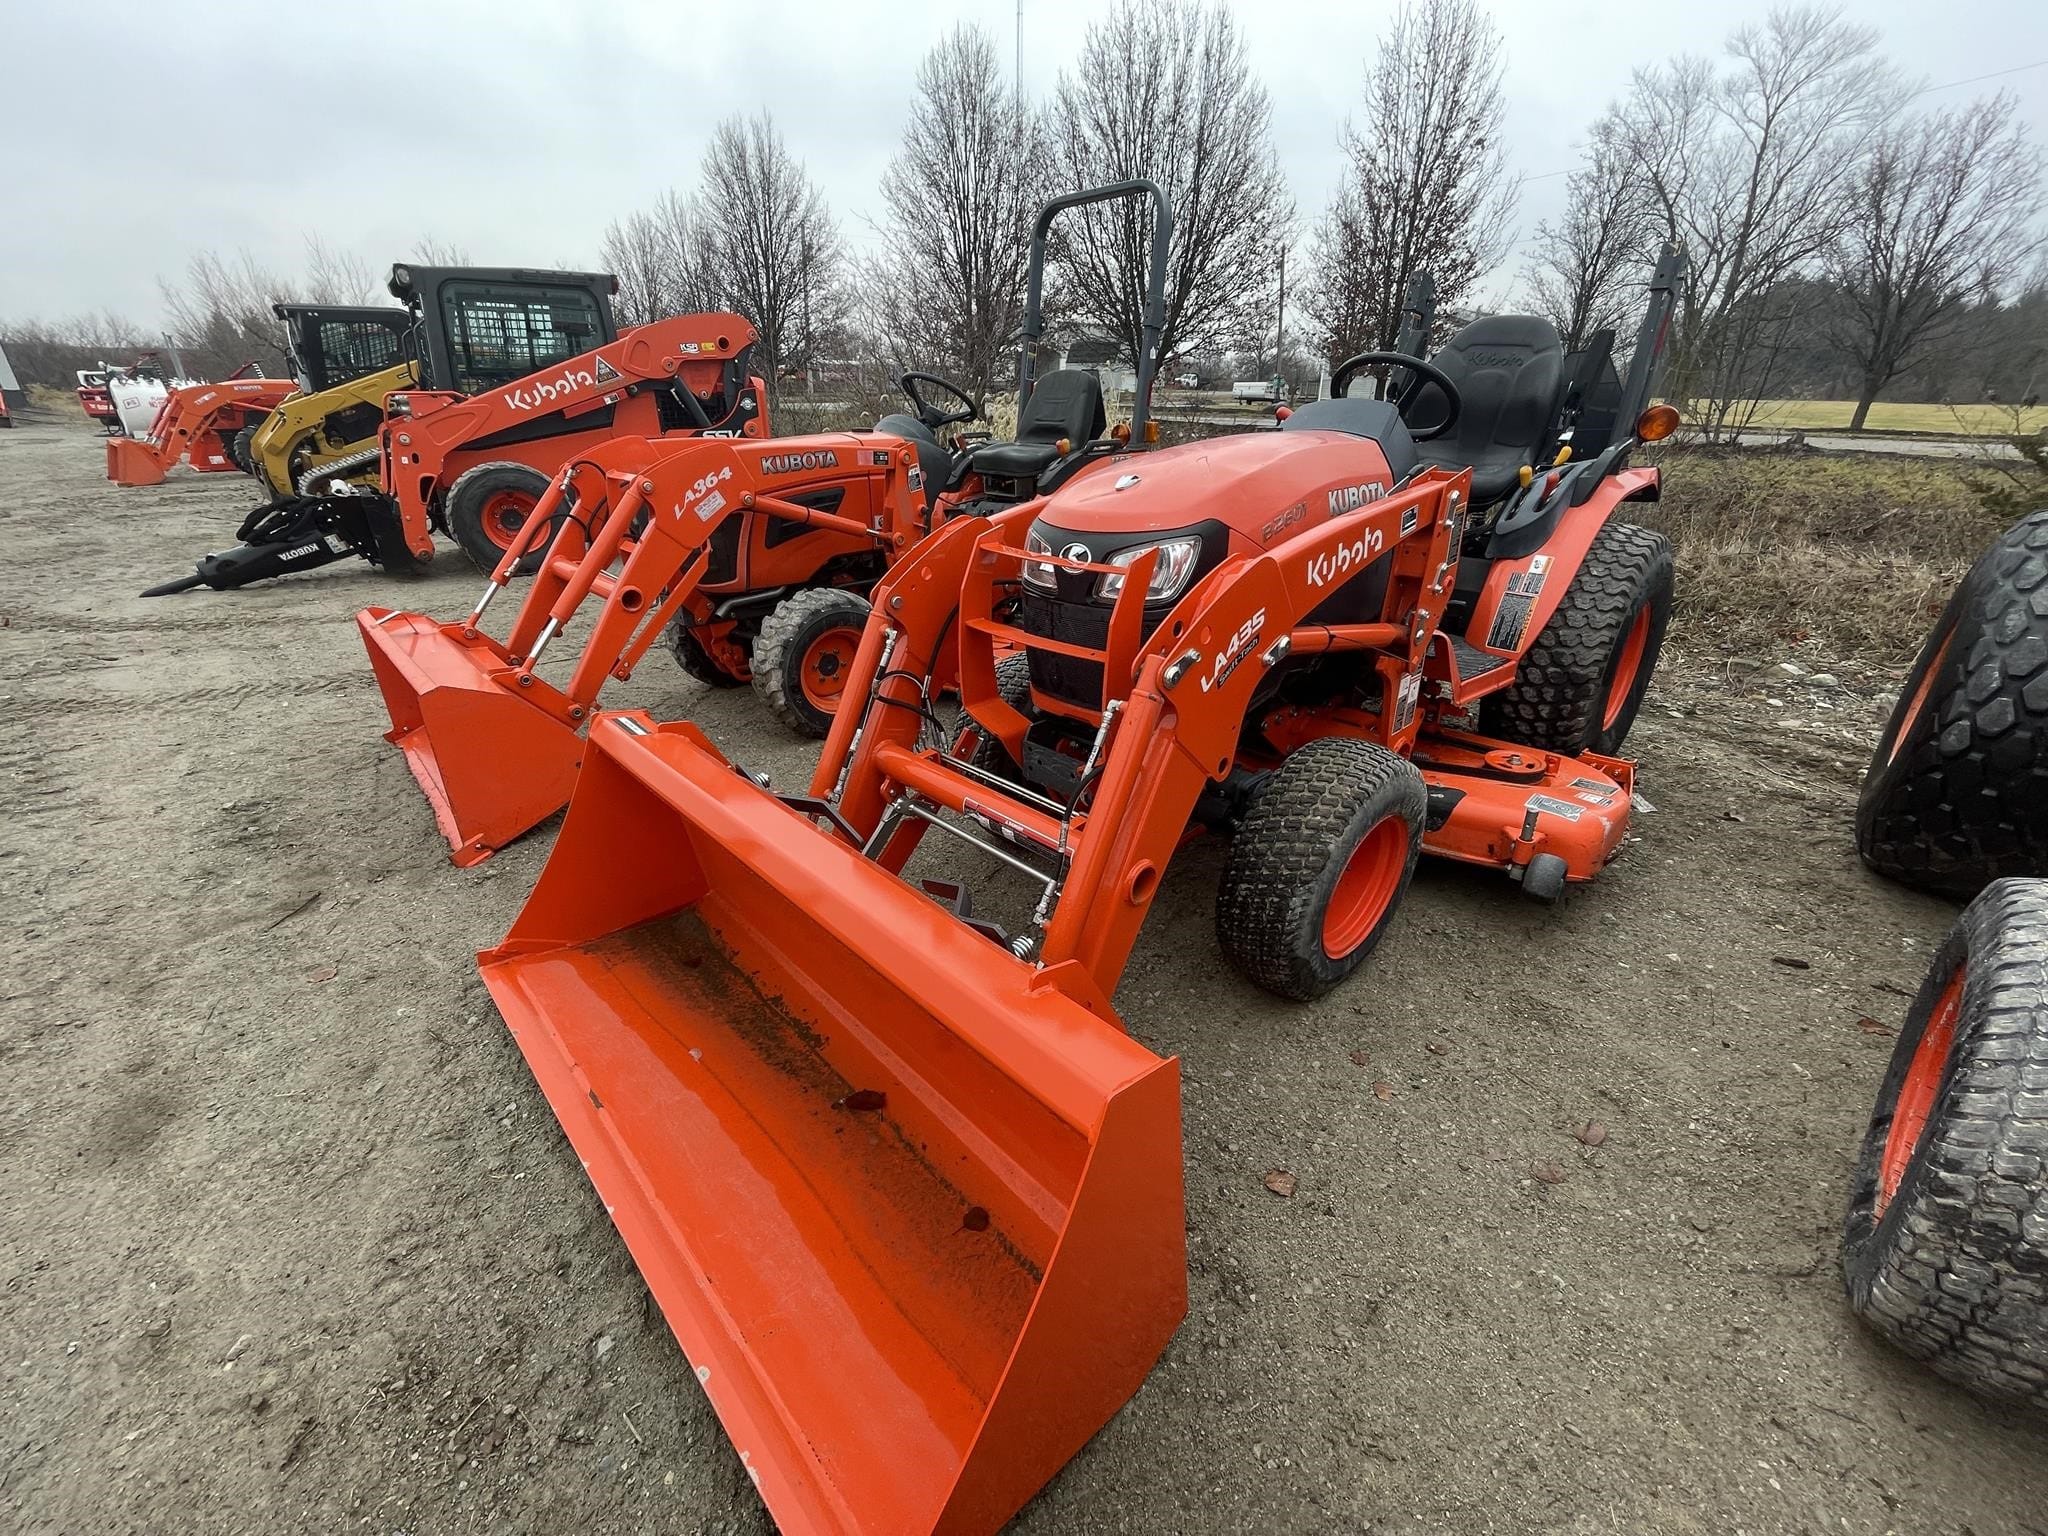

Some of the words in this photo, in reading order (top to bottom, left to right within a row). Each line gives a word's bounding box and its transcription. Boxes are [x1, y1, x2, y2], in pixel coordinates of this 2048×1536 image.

[1469, 352, 1524, 367] Kubota
[504, 370, 593, 410] Kubota
[761, 450, 838, 475] KUBOTA
[674, 466, 732, 520] LA364
[1328, 482, 1386, 517] KUBOTA
[1261, 501, 1307, 543] B2601
[277, 543, 319, 560] KUBOTA
[1307, 527, 1383, 587] Kubota
[1201, 607, 1265, 692] LA435
